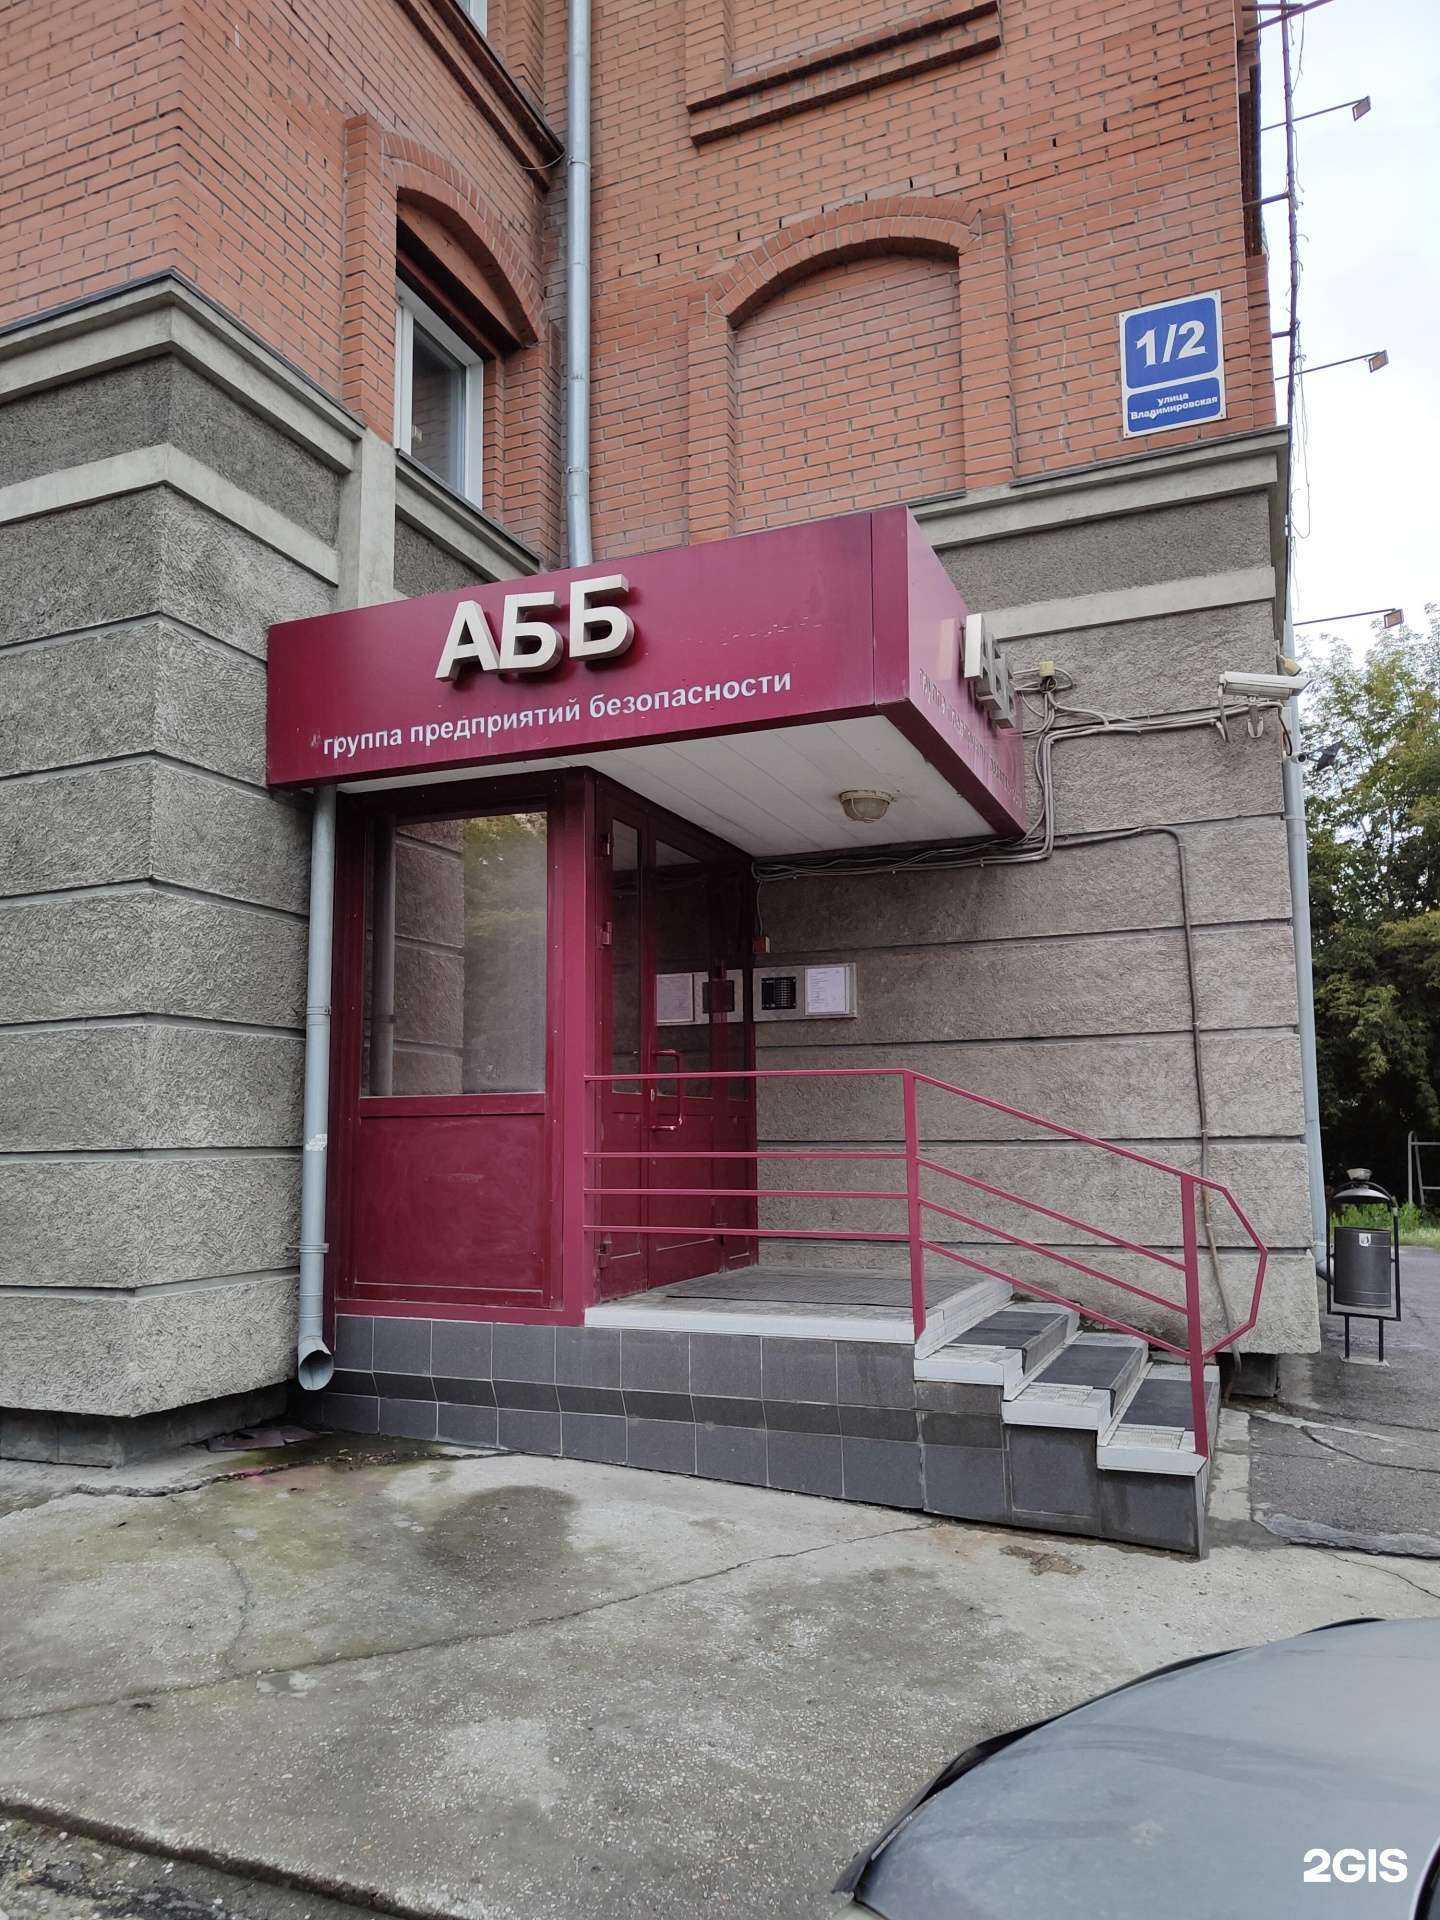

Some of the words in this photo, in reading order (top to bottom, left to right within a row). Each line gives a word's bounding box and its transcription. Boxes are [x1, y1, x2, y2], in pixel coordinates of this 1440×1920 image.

[1136, 320, 1208, 368] 1/2
[1130, 397, 1218, 420] Владимировская
[1157, 393, 1190, 406] улица
[435, 573, 636, 682] АББ
[322, 729, 402, 760] группа
[410, 697, 581, 747] предприятий
[589, 670, 792, 718] безопасности
